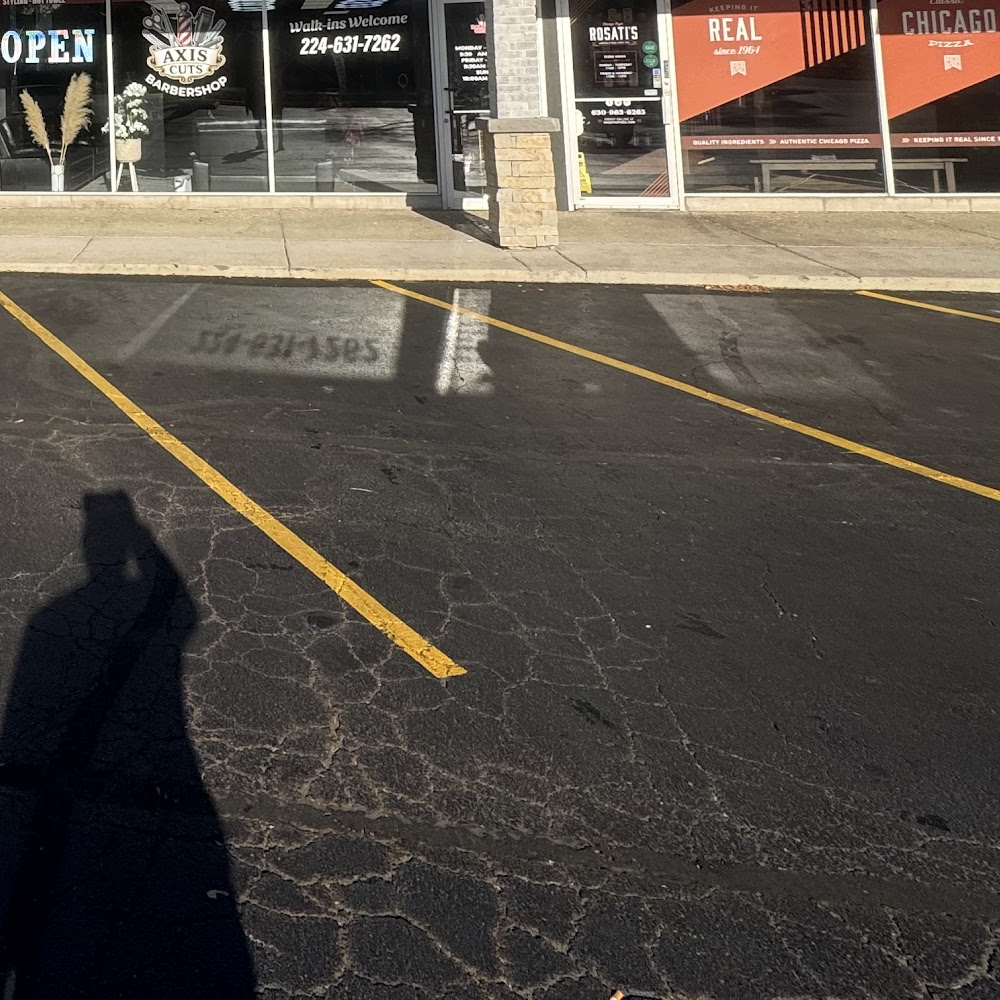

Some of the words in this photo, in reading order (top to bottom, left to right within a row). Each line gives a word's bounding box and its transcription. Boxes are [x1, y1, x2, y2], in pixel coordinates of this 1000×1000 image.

[709, 4, 747, 13] KEEPING
[289, 18, 347, 34] Walk-ins
[348, 14, 408, 29] Welcome
[708, 16, 763, 42] REAL
[902, 8, 996, 36] CHICAGO
[589, 26, 639, 42] ROSATI'S
[0, 29, 95, 64] OPEN
[300, 33, 401, 55] 224-631-7262
[713, 47, 736, 56] since
[737, 45, 760, 55] 1964
[927, 39, 975, 48] PIZZA
[163, 48, 207, 63] AXIS
[169, 64, 203, 75] CUTS
[144, 73, 228, 98] BARBERSHOP
